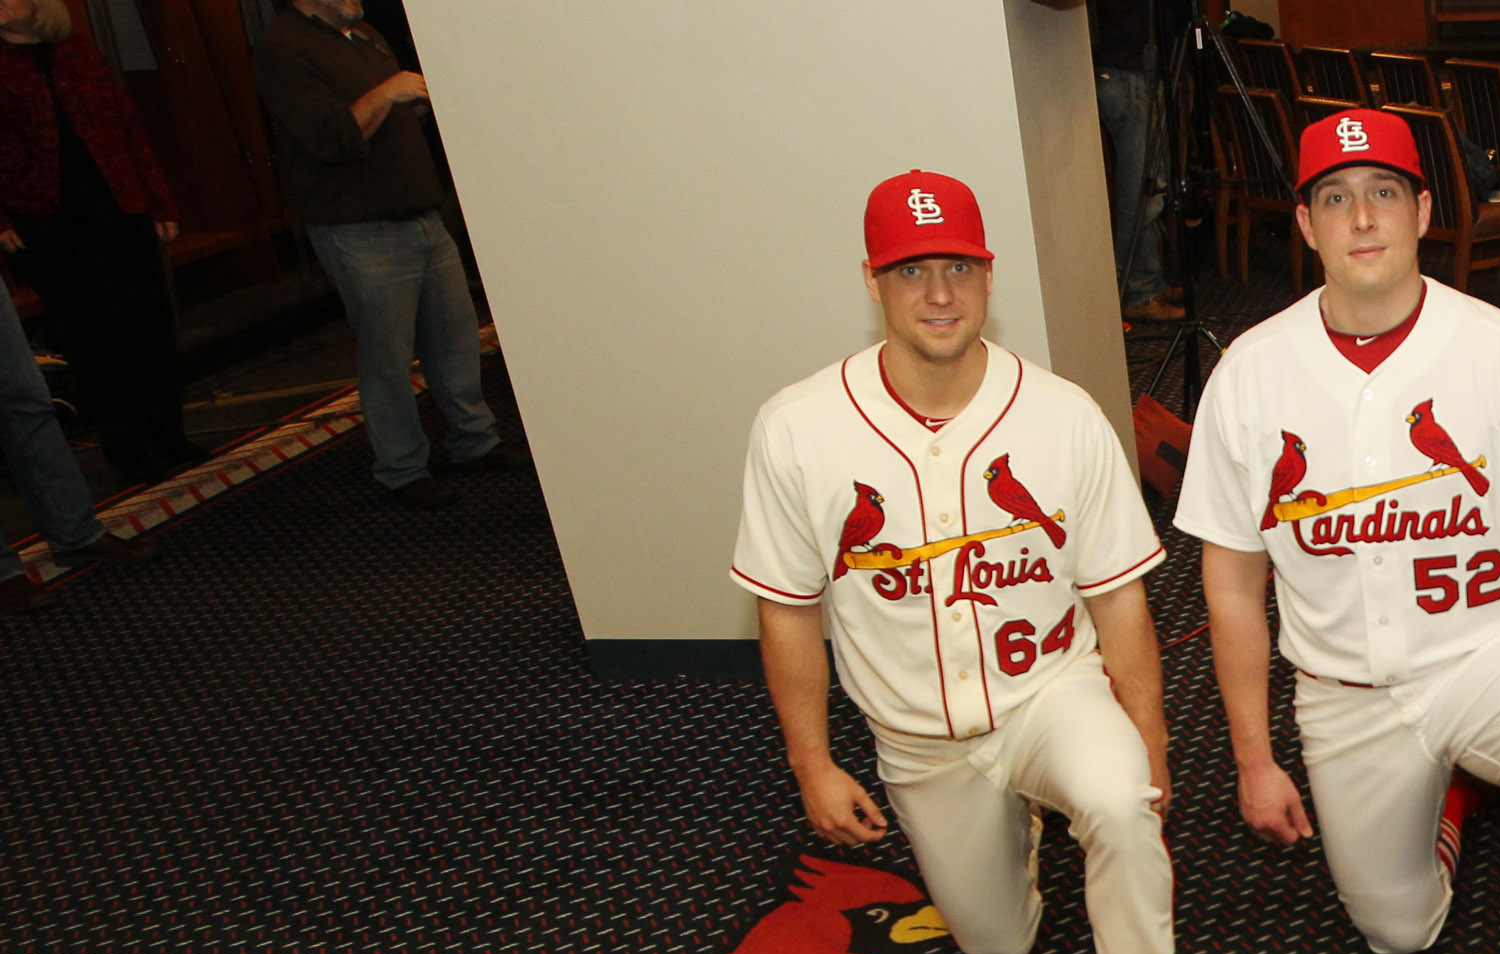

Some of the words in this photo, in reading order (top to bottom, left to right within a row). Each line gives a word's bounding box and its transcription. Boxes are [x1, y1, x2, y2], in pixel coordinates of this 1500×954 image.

[1292, 490, 1491, 557] Cardinals
[944, 540, 1054, 607] Louis
[994, 603, 1076, 677] 64
